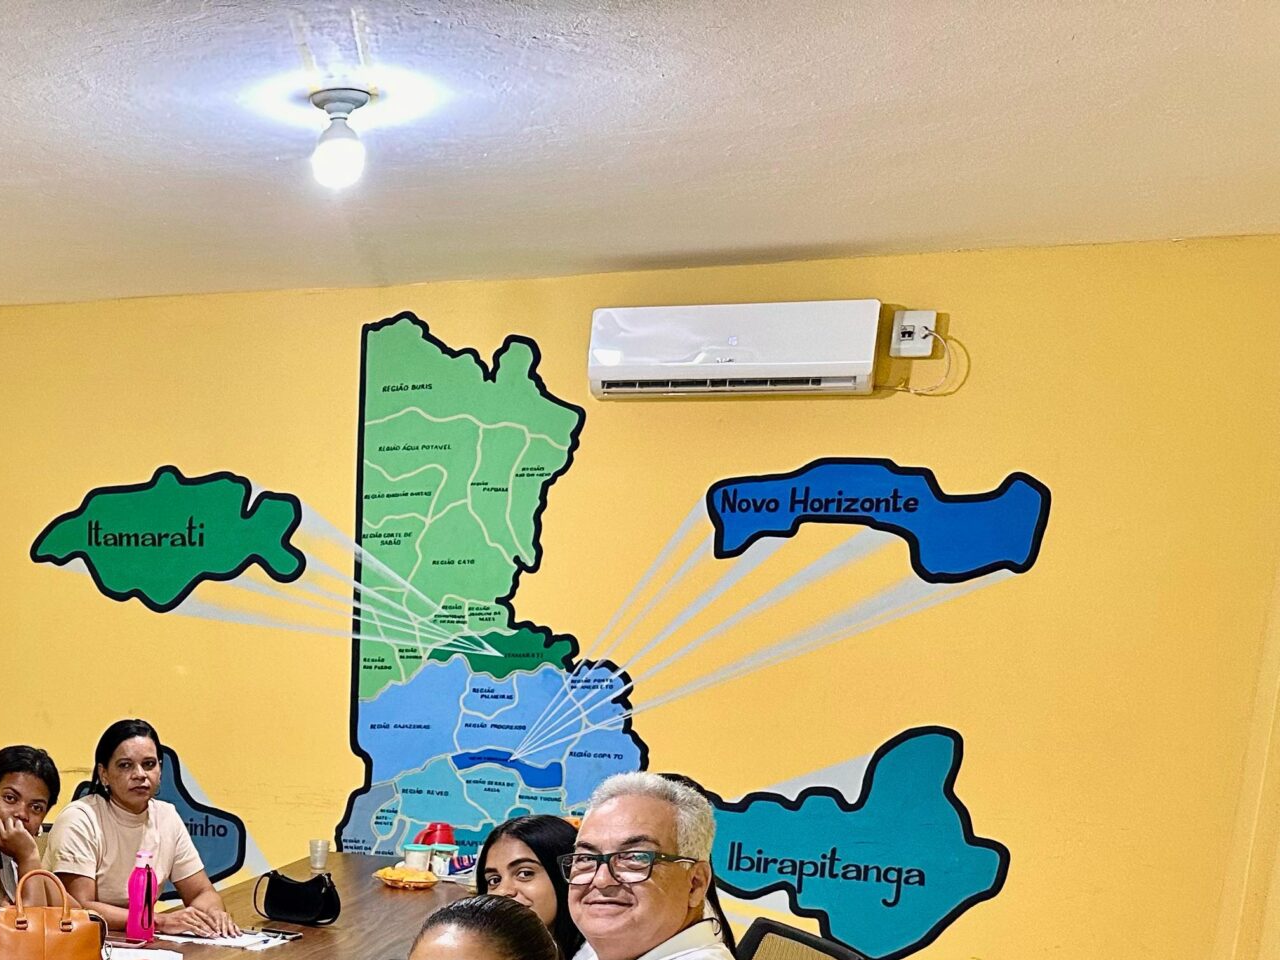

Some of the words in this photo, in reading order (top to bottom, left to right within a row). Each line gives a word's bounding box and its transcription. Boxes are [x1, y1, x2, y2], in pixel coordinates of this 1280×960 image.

[382, 383, 409, 392] REGIÃO
[721, 488, 780, 514] Novo
[789, 486, 920, 514] Horizonte
[87, 515, 205, 547] Itamarati
[370, 722, 390, 730] REGIÃO
[569, 750, 592, 758] REGIÃO
[727, 840, 926, 908] Ibirapitanga
